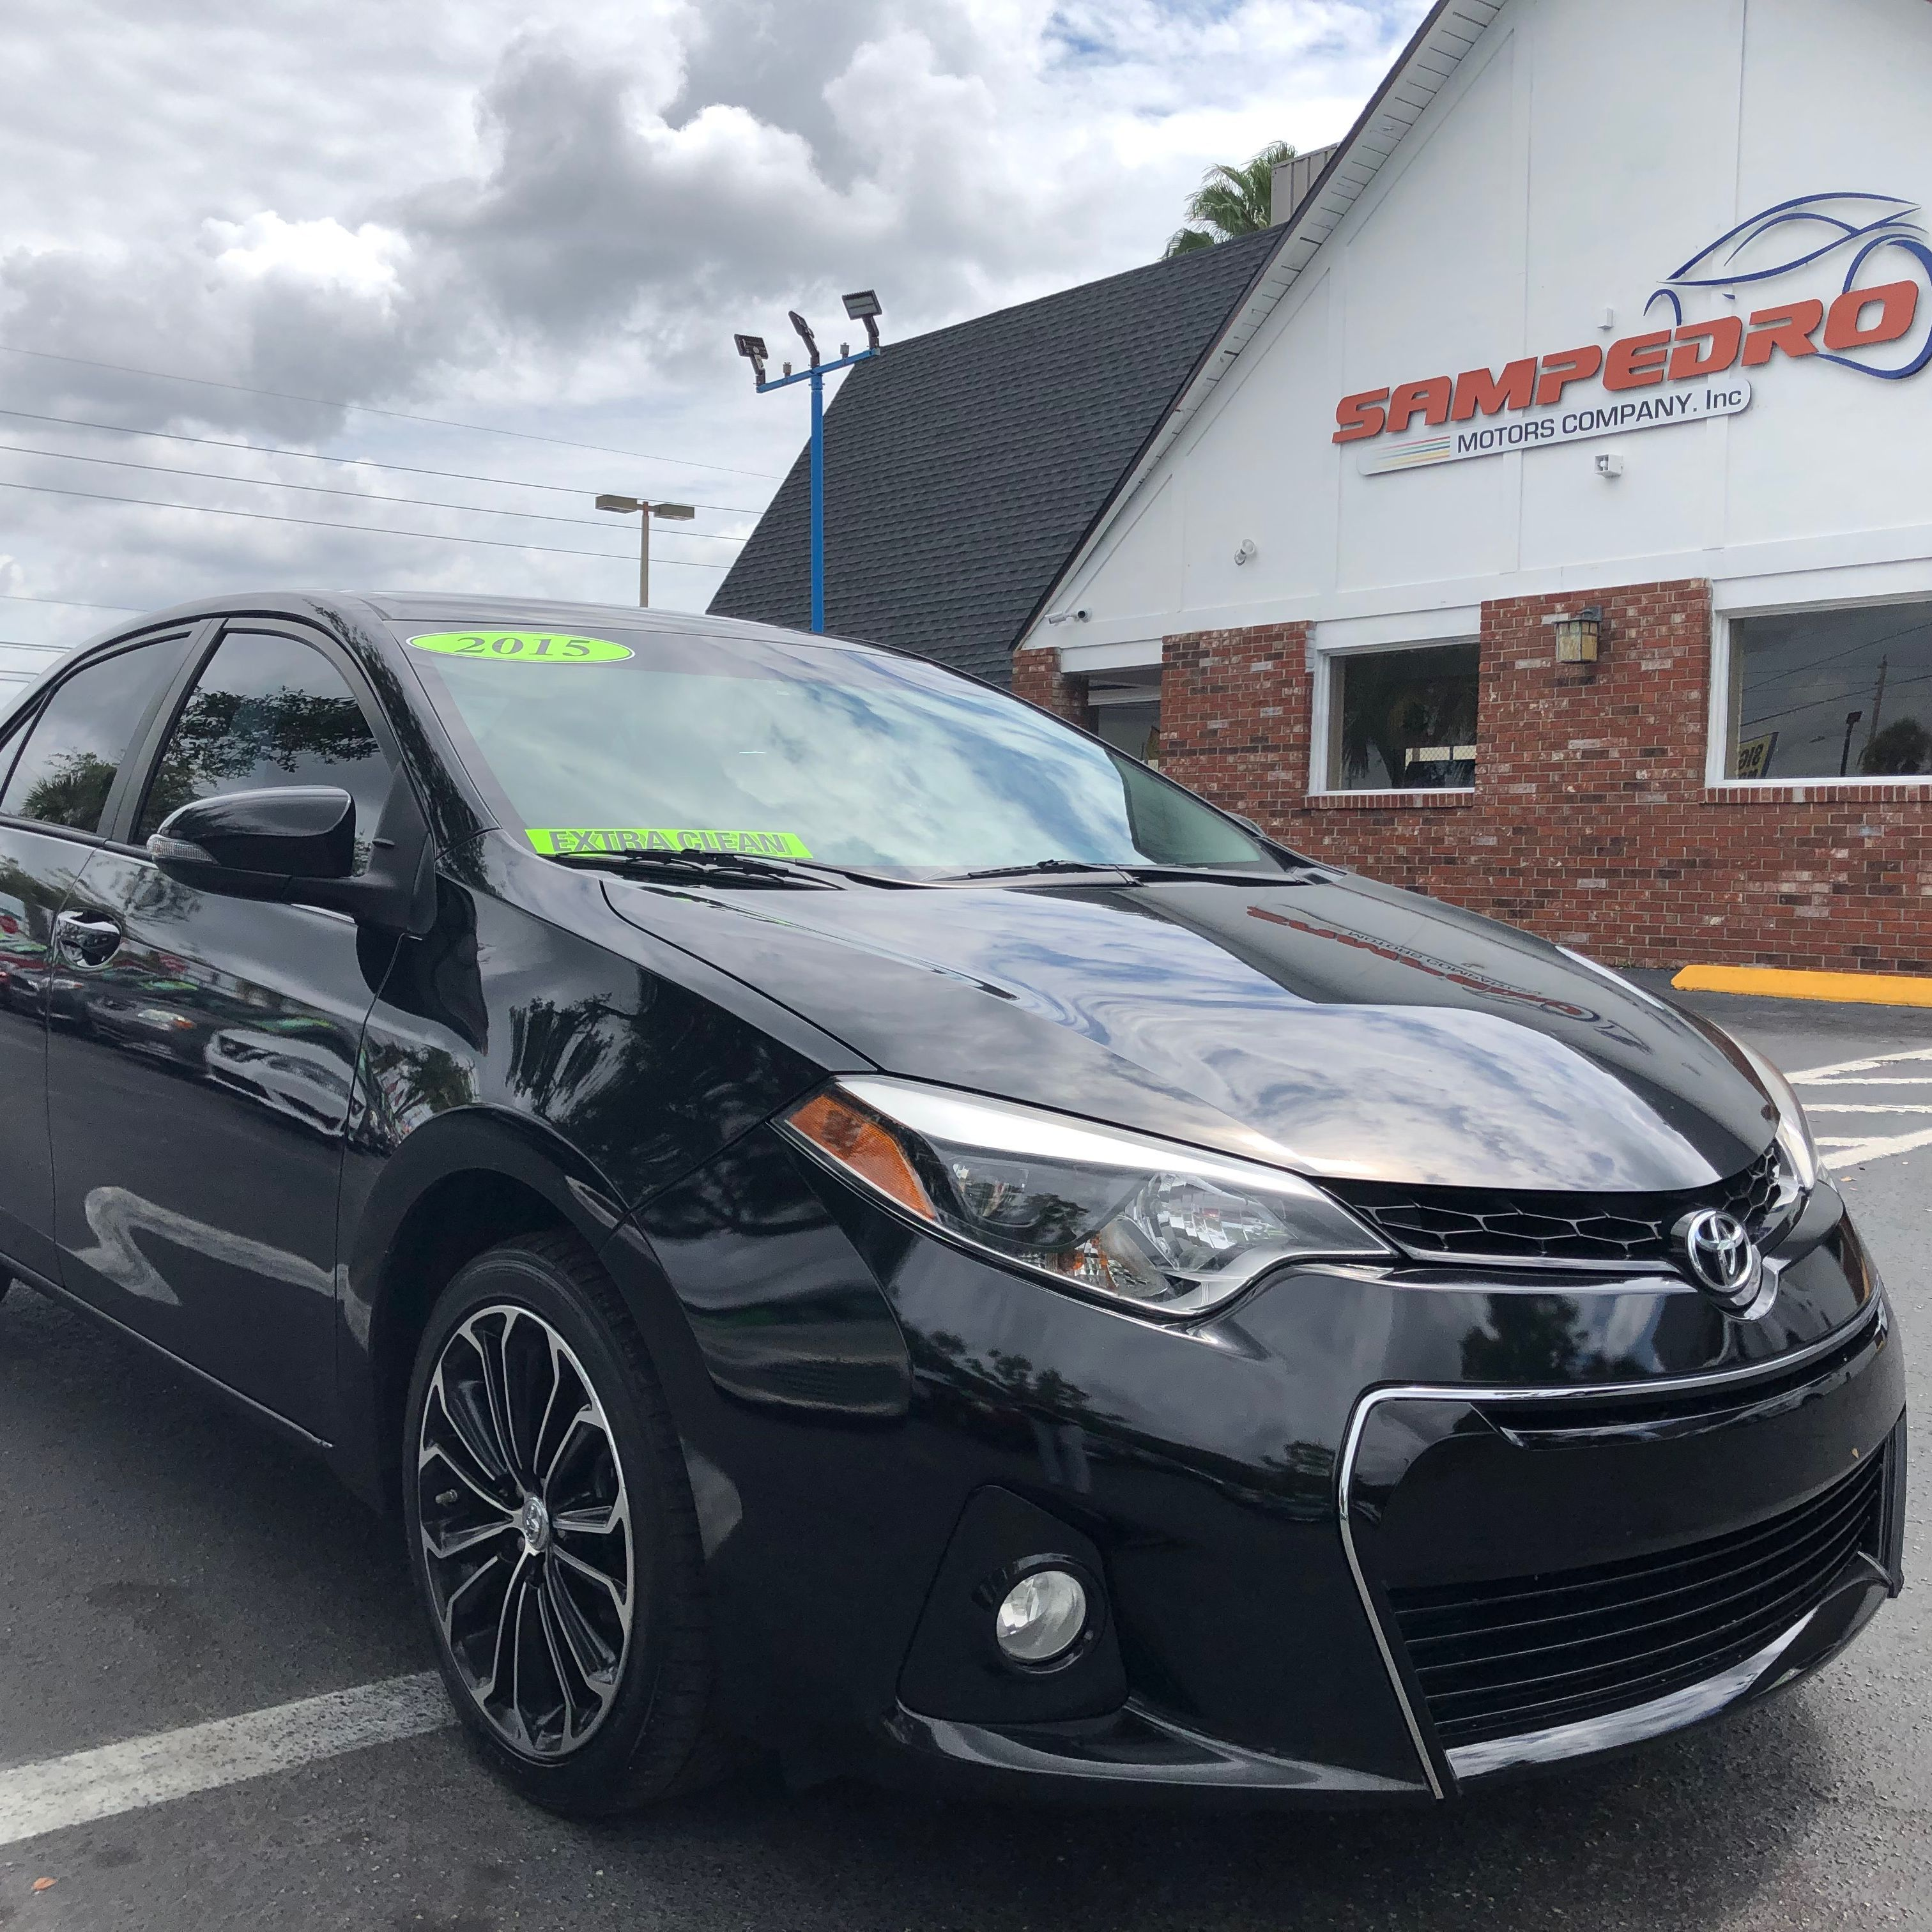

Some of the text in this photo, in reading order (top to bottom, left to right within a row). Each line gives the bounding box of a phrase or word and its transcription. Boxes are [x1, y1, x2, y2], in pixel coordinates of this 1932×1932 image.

[1332, 279, 1919, 443] SAMPEDRO
[1457, 418, 1554, 453] MOTORS
[1706, 389, 1742, 410] Inc
[454, 637, 590, 659] 2015
[551, 831, 791, 855] EXTRA CLEAN
